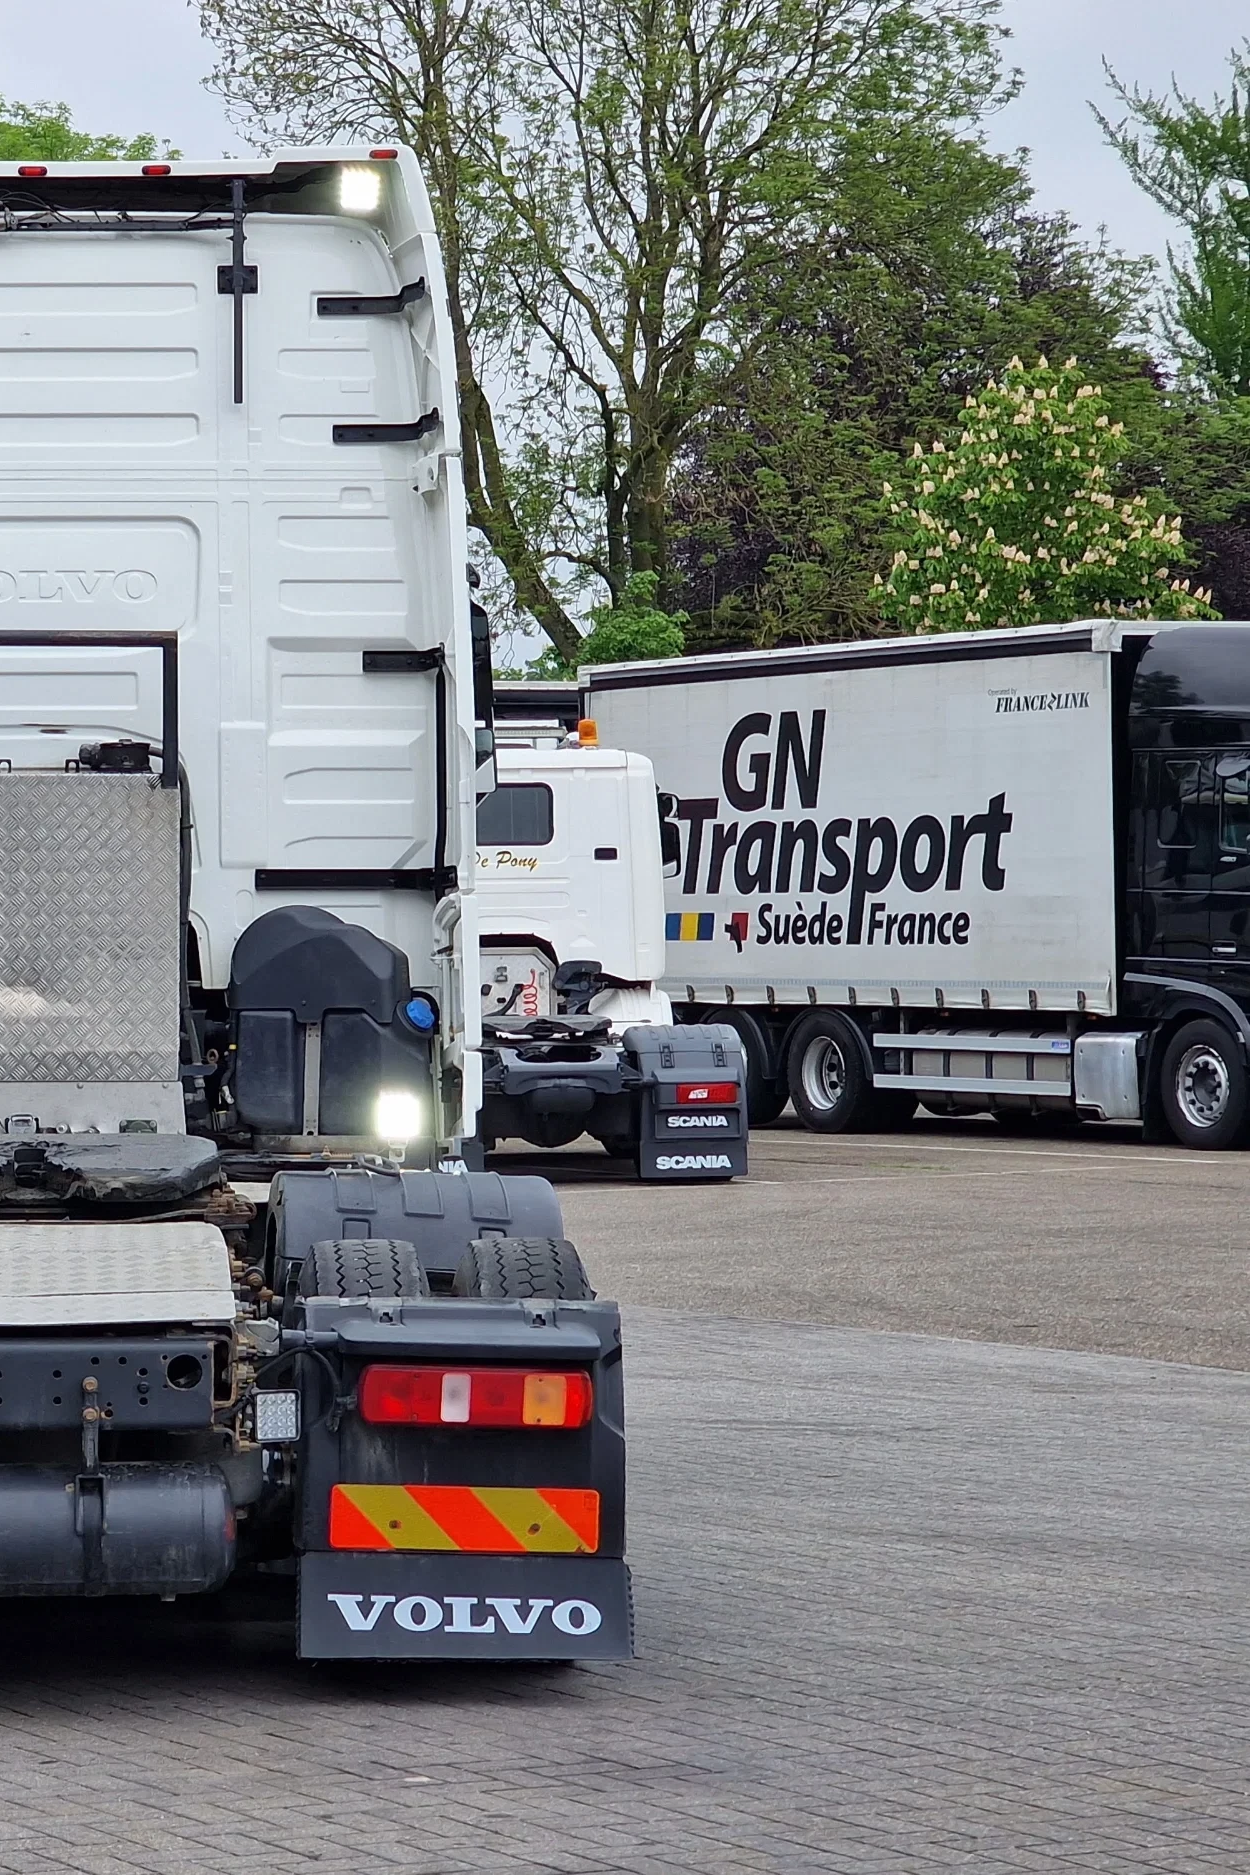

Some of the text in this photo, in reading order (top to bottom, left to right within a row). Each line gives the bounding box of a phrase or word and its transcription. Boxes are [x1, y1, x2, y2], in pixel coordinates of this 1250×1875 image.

[995, 691, 1090, 713] FRANCE LINK
[721, 708, 828, 813] GN
[495, 850, 538, 873] Pony
[677, 791, 1014, 946] Transport
[755, 901, 971, 946] Suède France
[666, 1114, 729, 1128] SCANIA
[655, 1154, 732, 1170] SCANIA
[326, 1593, 603, 1636] VOLVO
